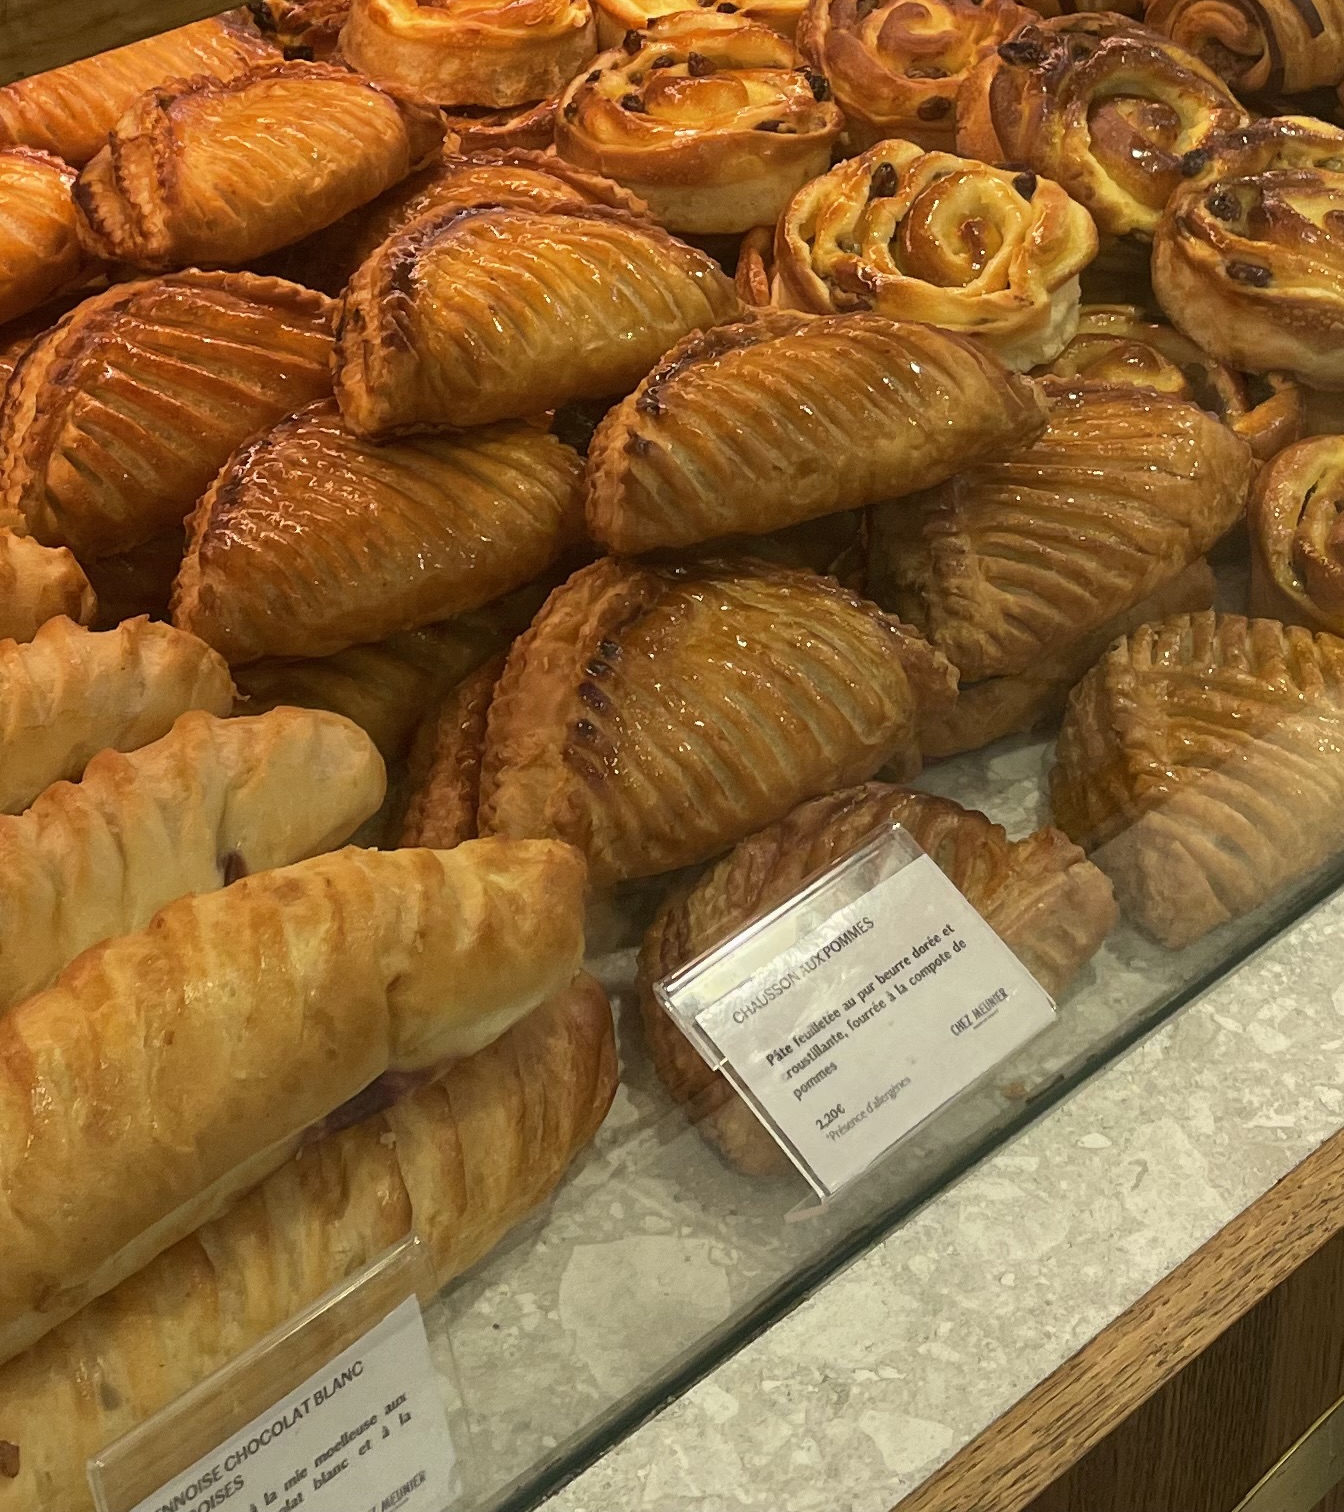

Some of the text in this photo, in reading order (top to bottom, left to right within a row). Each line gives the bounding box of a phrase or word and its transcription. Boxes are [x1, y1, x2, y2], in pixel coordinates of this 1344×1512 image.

[732, 916, 875, 1024] CHAUSSON AUX POMMES
[765, 923, 956, 1067] Pâte feuilletée au pur beurre dorée et
[846, 999, 887, 1032] fourrée
[885, 990, 897, 1003] à
[894, 982, 909, 996] la
[908, 950, 953, 987] compote
[952, 938, 967, 954] de
[950, 987, 1009, 1037] CHEZ MEUNIER
[793, 1061, 838, 1101] pommes
[224, 1398, 312, 1472] CHOCOLAT
[314, 1360, 364, 1407] BLANC
[263, 1491, 278, 1507] la
[284, 1467, 308, 1491] mie
[313, 1413, 378, 1468] moelleuse
[384, 1392, 408, 1416] aux
[313, 1458, 349, 1491] blanc
[358, 1439, 372, 1456] et
[382, 1425, 391, 1439] à
[398, 1410, 412, 1426] la
